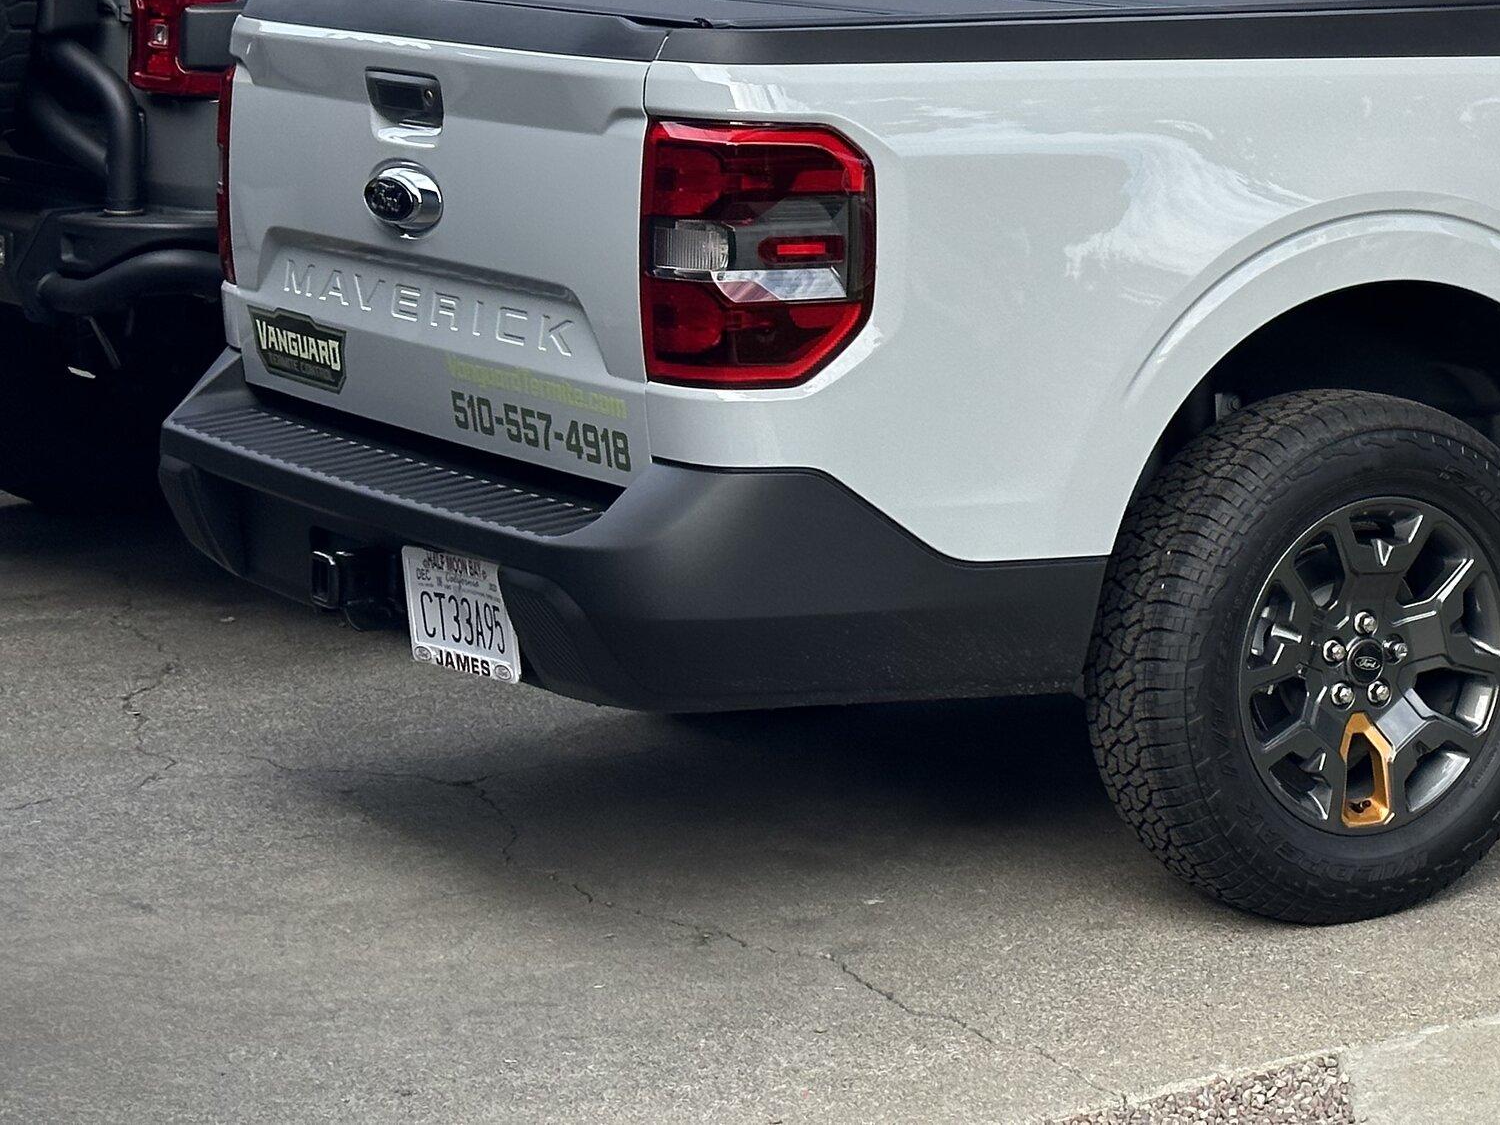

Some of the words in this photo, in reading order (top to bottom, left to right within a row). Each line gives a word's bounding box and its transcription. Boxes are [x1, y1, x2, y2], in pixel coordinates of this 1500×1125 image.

[283, 259, 574, 357] MAVERICK
[255, 318, 341, 372] VANGUARD
[450, 389, 632, 473] 510-557-4918
[416, 567, 432, 581] DEC
[420, 590, 505, 655] CT33A95
[435, 649, 491, 677] JAMES
